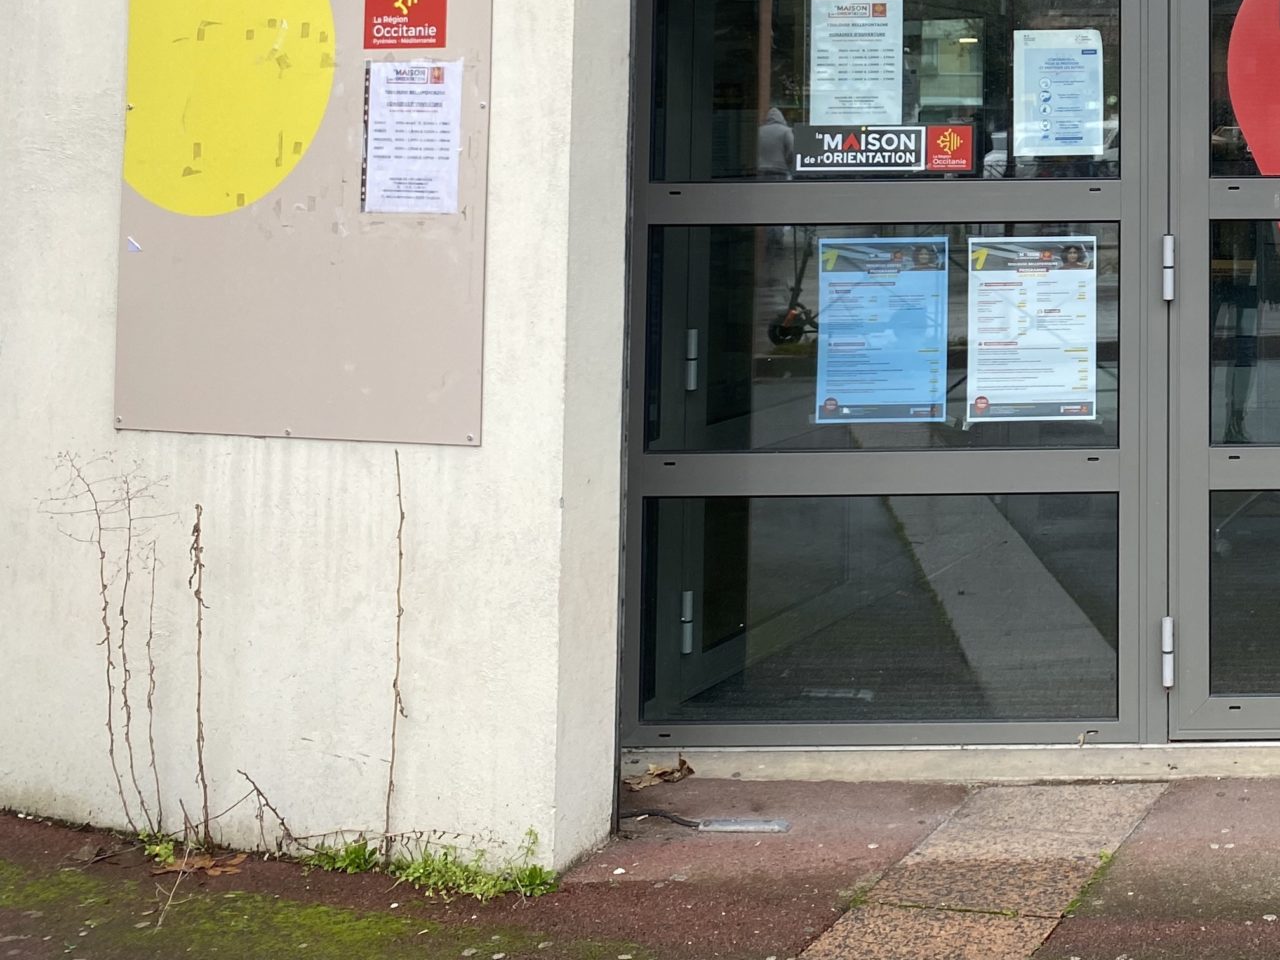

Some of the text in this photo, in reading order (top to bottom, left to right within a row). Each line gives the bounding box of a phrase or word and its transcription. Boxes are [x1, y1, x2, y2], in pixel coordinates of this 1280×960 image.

[383, 15, 409, 25] Région
[373, 23, 437, 37] Occitanie
[823, 133, 915, 150] MAISON
[804, 155, 815, 164] de
